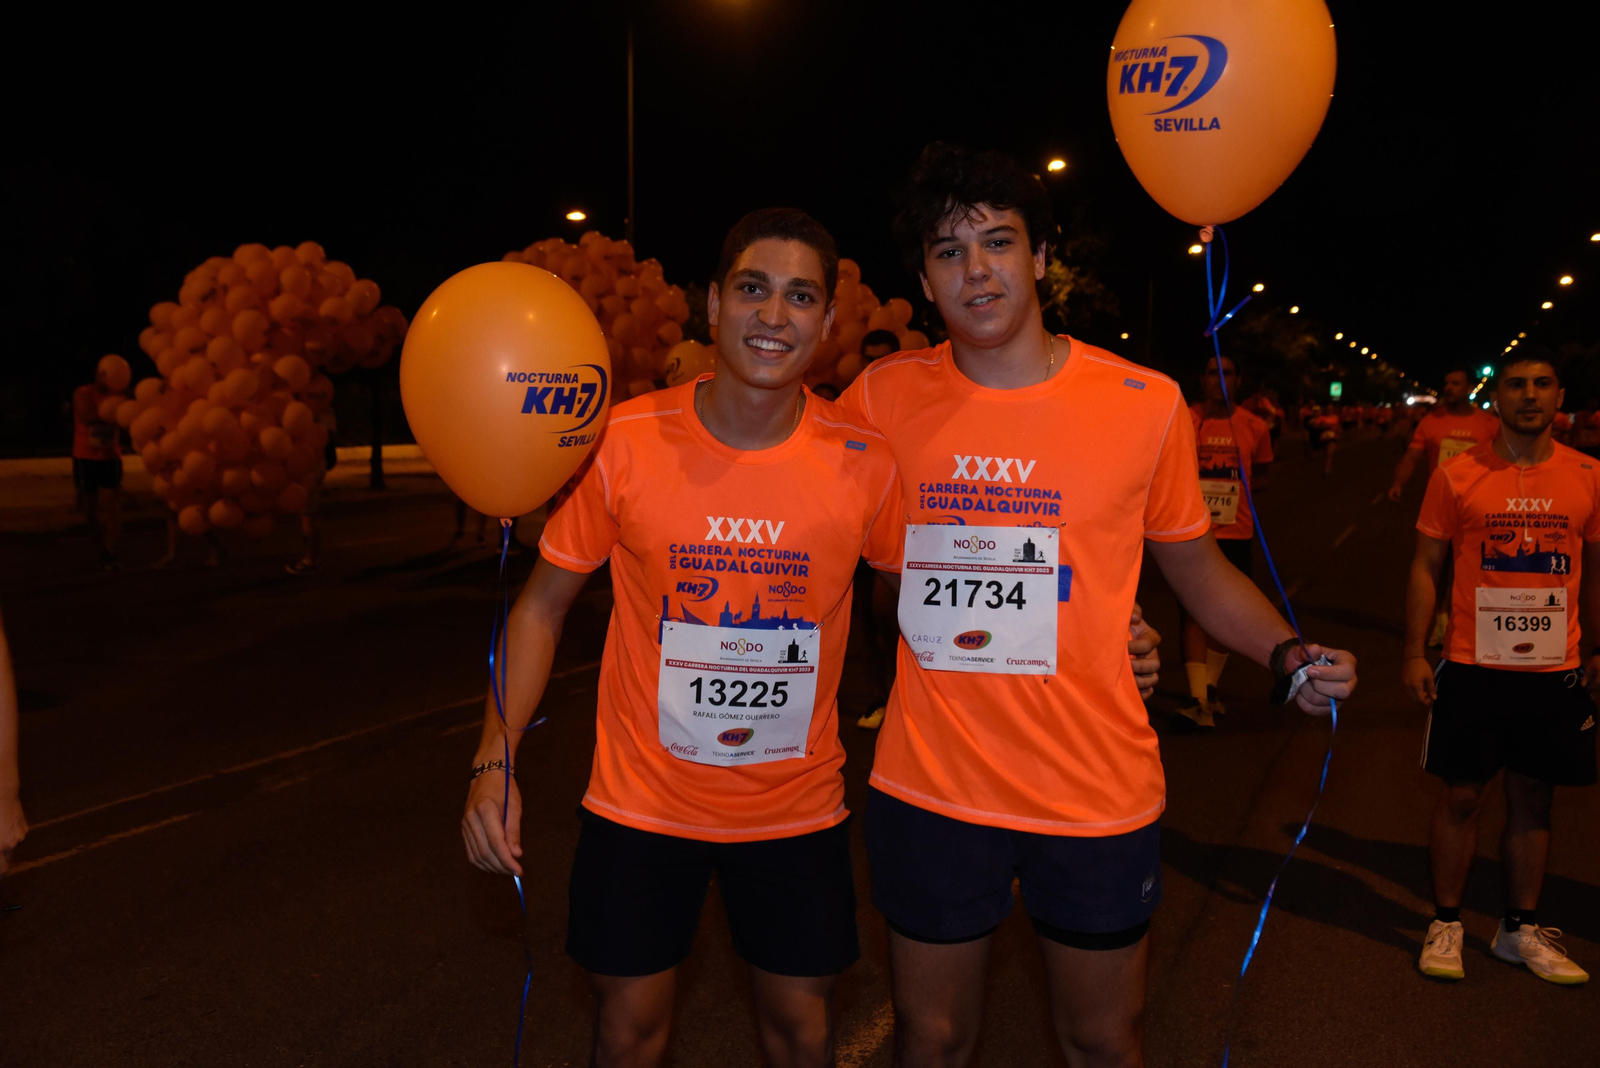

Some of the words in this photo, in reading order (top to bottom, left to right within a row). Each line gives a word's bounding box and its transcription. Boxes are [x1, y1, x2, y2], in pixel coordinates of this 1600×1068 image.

[1114, 45, 1168, 62] NOCTURNA
[1154, 117, 1221, 132] SEVILLA
[506, 372, 579, 384] NOCTURNA
[558, 432, 597, 448] SEVILLA
[951, 454, 1037, 484] XXXV
[919, 483, 979, 495] CARRERA
[985, 485, 1063, 501] NOCTURNA
[927, 497, 1061, 516] GUADALQUIVIR
[1506, 498, 1553, 512] XXXV
[1491, 520, 1569, 529] GUADALQUIVIR
[1525, 513, 1569, 521] NOCTURNA
[704, 515, 786, 545] XXXV
[669, 544, 733, 557] CARRERA
[738, 547, 811, 562] NOCTURNA
[669, 554, 677, 570] DEL
[679, 557, 810, 578] GUADALQUIVIR
[983, 565, 1024, 573] GUADALQUIVIR
[923, 577, 1027, 610] 21734
[1493, 615, 1552, 632] 16399
[911, 634, 942, 645] CARUZ
[683, 661, 708, 669] CARRERA
[708, 664, 739, 672] NOCTURNA
[748, 666, 788, 674] GUADALQUIVIR
[1006, 657, 1048, 667] Cruzcampo
[689, 677, 789, 708] 13225
[692, 710, 718, 719] RAFAEL
[718, 711, 744, 720] GÓMEZ
[745, 713, 781, 721] GUERRERO
[764, 745, 800, 755] Cruzcampo
